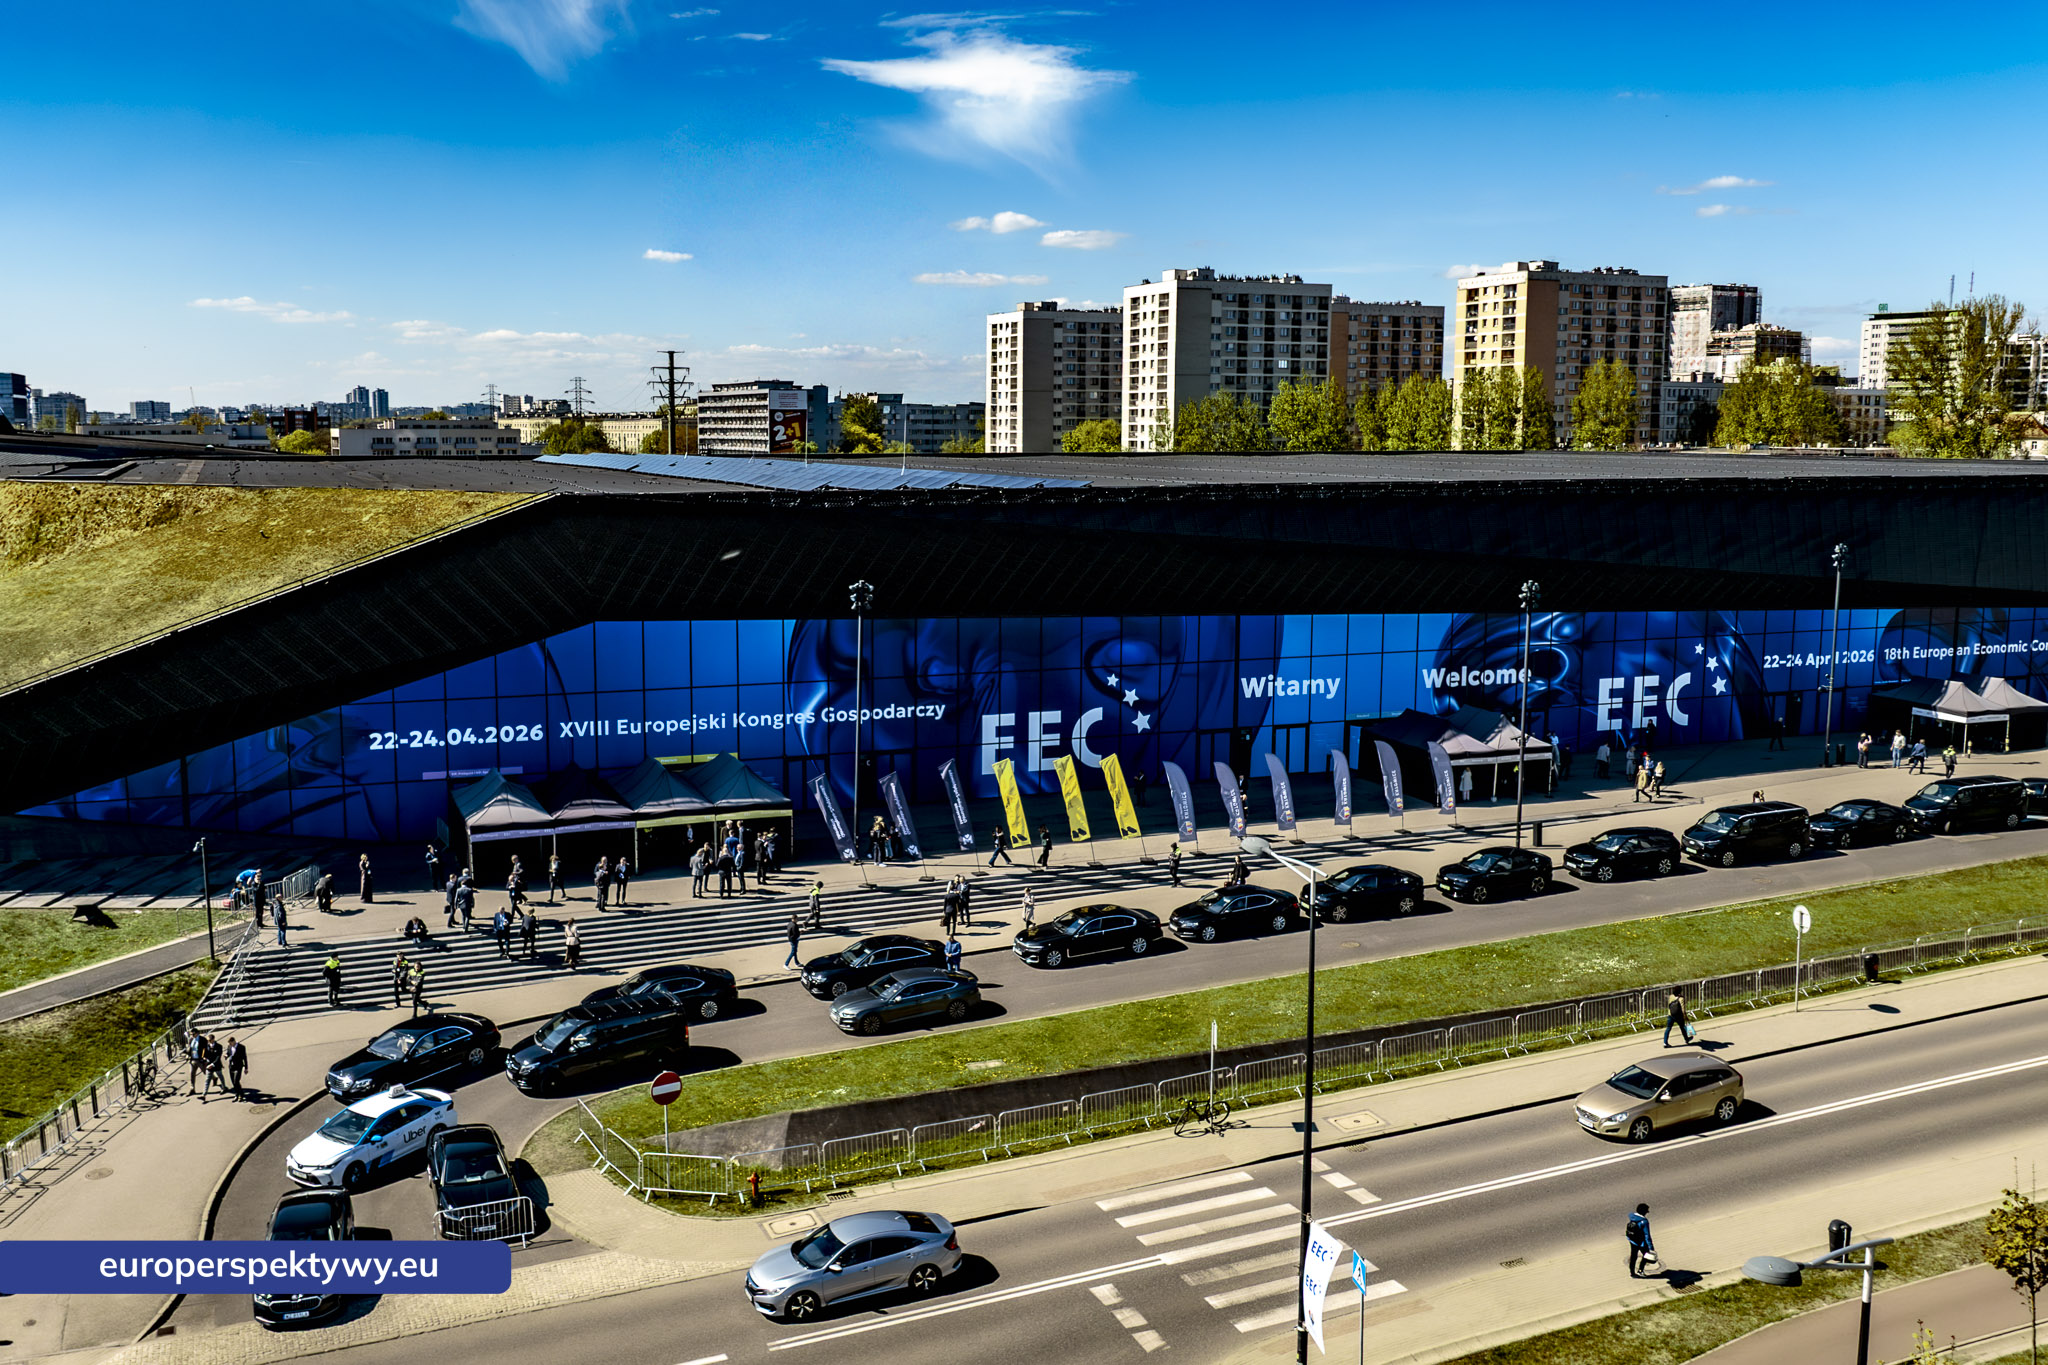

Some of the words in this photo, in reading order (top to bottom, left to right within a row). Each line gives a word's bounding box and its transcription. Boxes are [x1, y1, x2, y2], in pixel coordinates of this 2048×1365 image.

[773, 422, 801, 441] 2+1
[1805, 651, 1840, 669] Aprl
[1842, 649, 1875, 664] 2026
[1884, 646, 1910, 660] 18th
[1913, 646, 1971, 660] European
[1973, 640, 2028, 655] Economic
[1241, 674, 1341, 700] Witamy
[1422, 665, 1532, 689] Welcome
[1596, 672, 1691, 731] EEC
[559, 719, 610, 738] XVIII
[617, 712, 726, 736] Europejski
[732, 710, 815, 730] Kongres
[821, 703, 946, 724] Gospodarczy
[369, 724, 544, 750] 22-24.04.2026
[982, 706, 1104, 775] EEC
[403, 1124, 427, 1144] Uber
[1311, 1240, 1328, 1262] EEC
[1305, 1274, 1317, 1296] EEC
